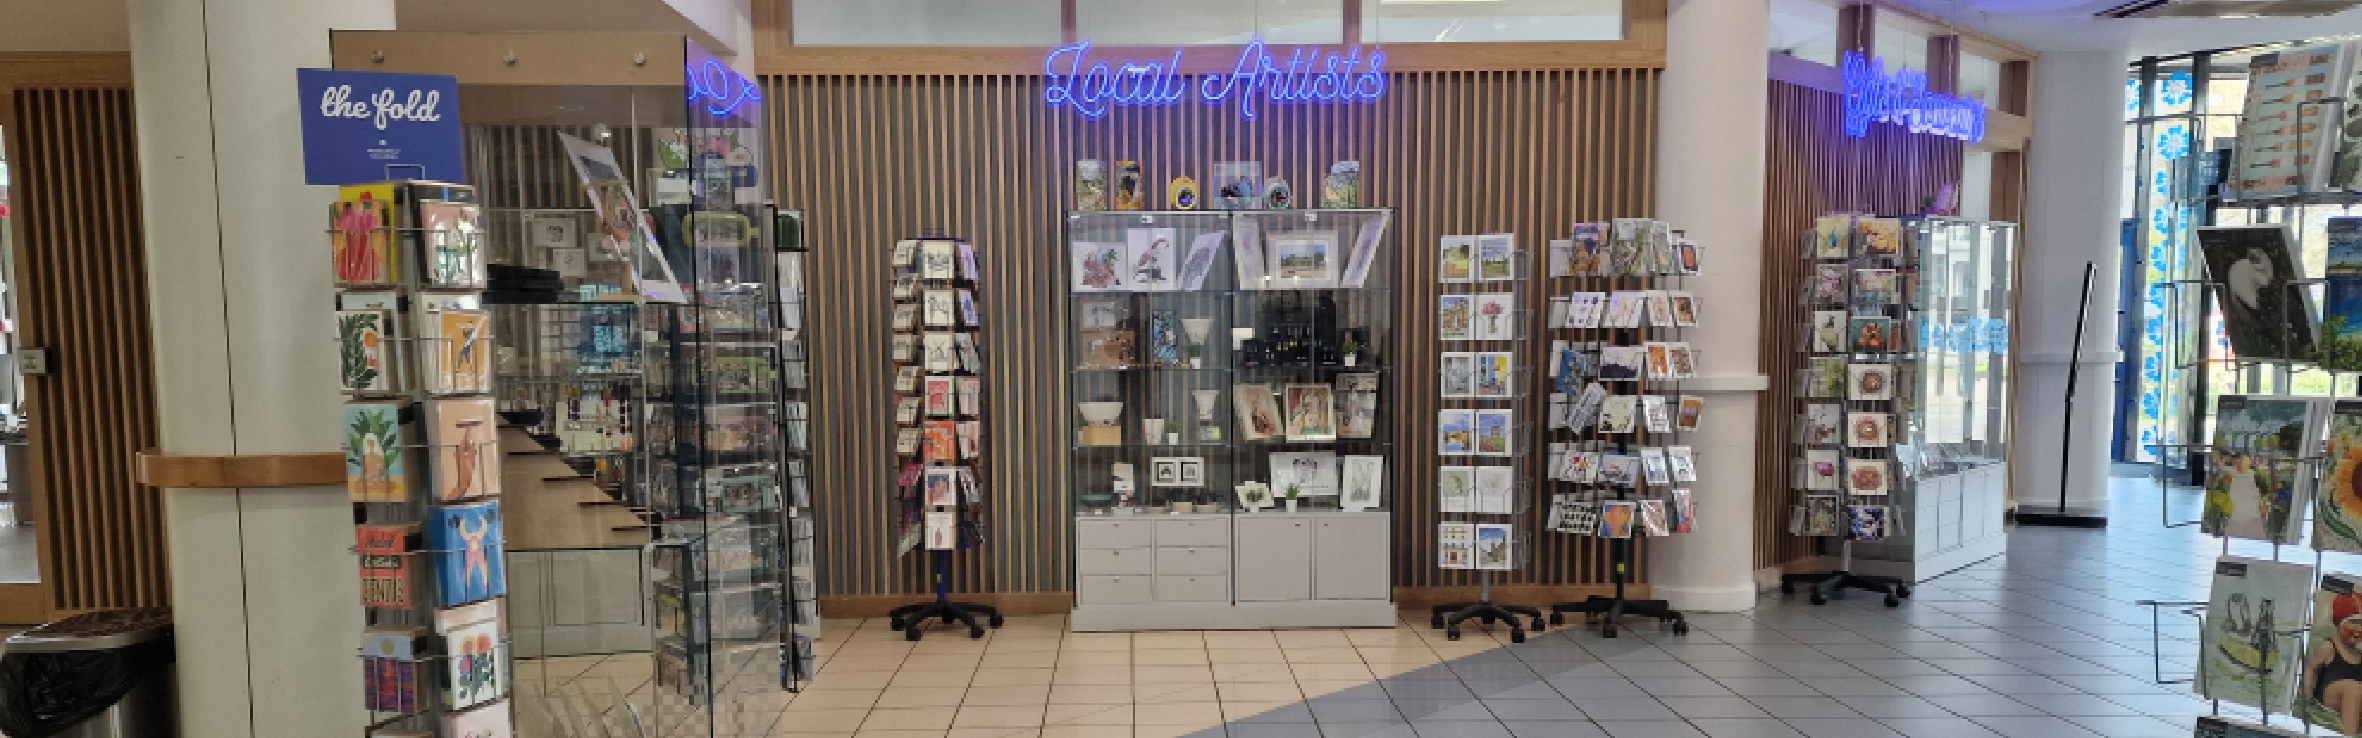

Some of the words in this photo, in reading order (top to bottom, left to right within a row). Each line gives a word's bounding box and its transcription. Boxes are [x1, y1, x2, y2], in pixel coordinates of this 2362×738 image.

[320, 85, 371, 118] the
[371, 88, 441, 130] fold
[1046, 40, 1187, 117] Local
[1201, 40, 1384, 117] Artists
